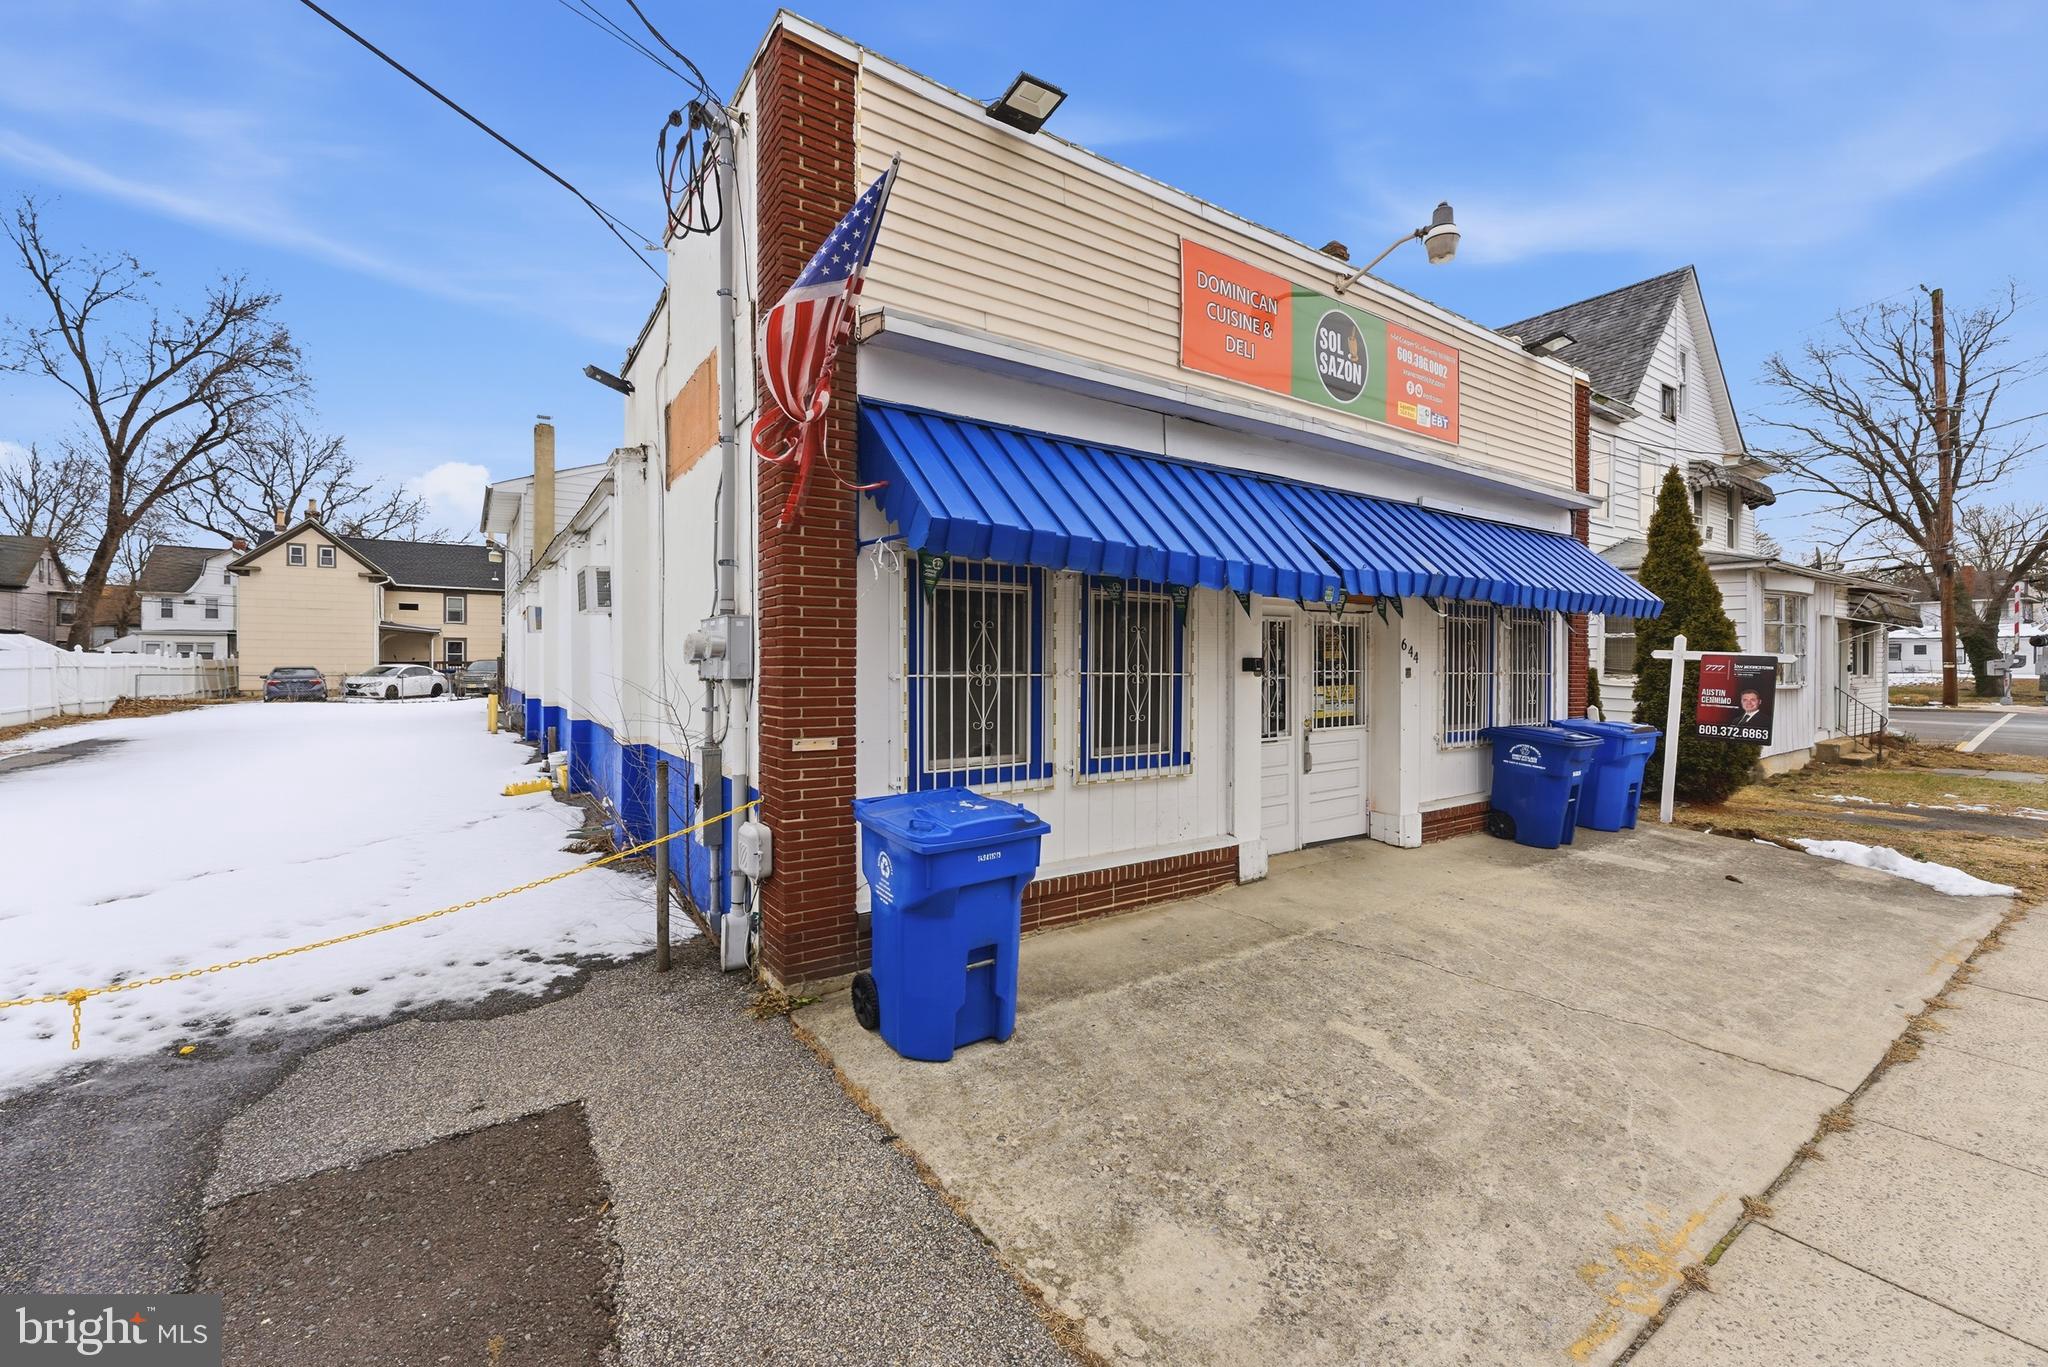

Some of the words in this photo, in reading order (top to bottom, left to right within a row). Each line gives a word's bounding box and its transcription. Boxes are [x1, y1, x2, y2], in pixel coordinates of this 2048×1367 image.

[1196, 270, 1278, 315] DOMINICAN
[1206, 302, 1260, 334] CUISINE
[1263, 321, 1274, 339] &
[1225, 335, 1256, 360] DELI
[1319, 327, 1344, 355] SOL
[1431, 416, 1449, 429] EBT
[1401, 638, 1419, 664] 644
[1698, 724, 1769, 740] 609.372.6863
